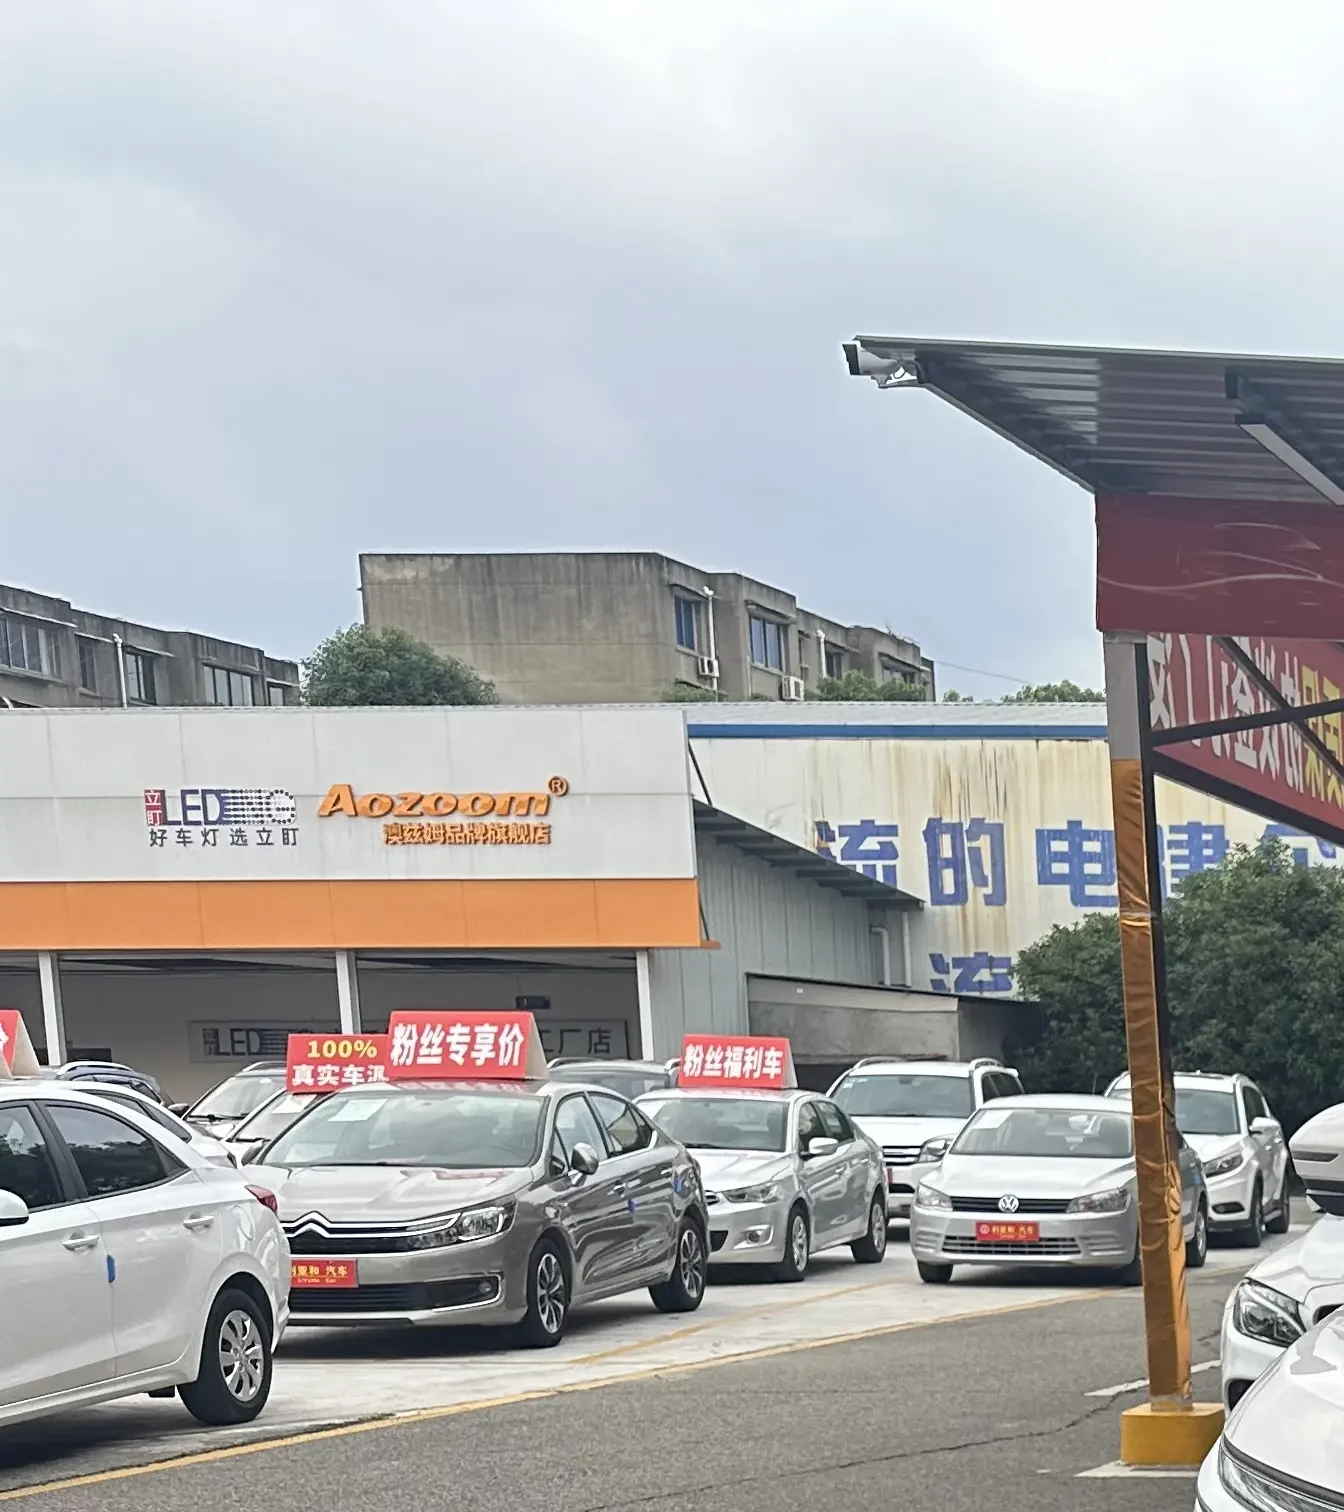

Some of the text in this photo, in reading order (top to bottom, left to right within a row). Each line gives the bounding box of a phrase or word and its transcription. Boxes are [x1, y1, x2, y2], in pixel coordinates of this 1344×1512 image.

[149, 828, 299, 848] 好车灯选立盯
[383, 822, 552, 845] 澳兹姆品牌旗舰店
[307, 1040, 378, 1059] 100%
[390, 1022, 525, 1067] 粉丝专享价
[683, 1043, 784, 1080] 粉丝福利车
